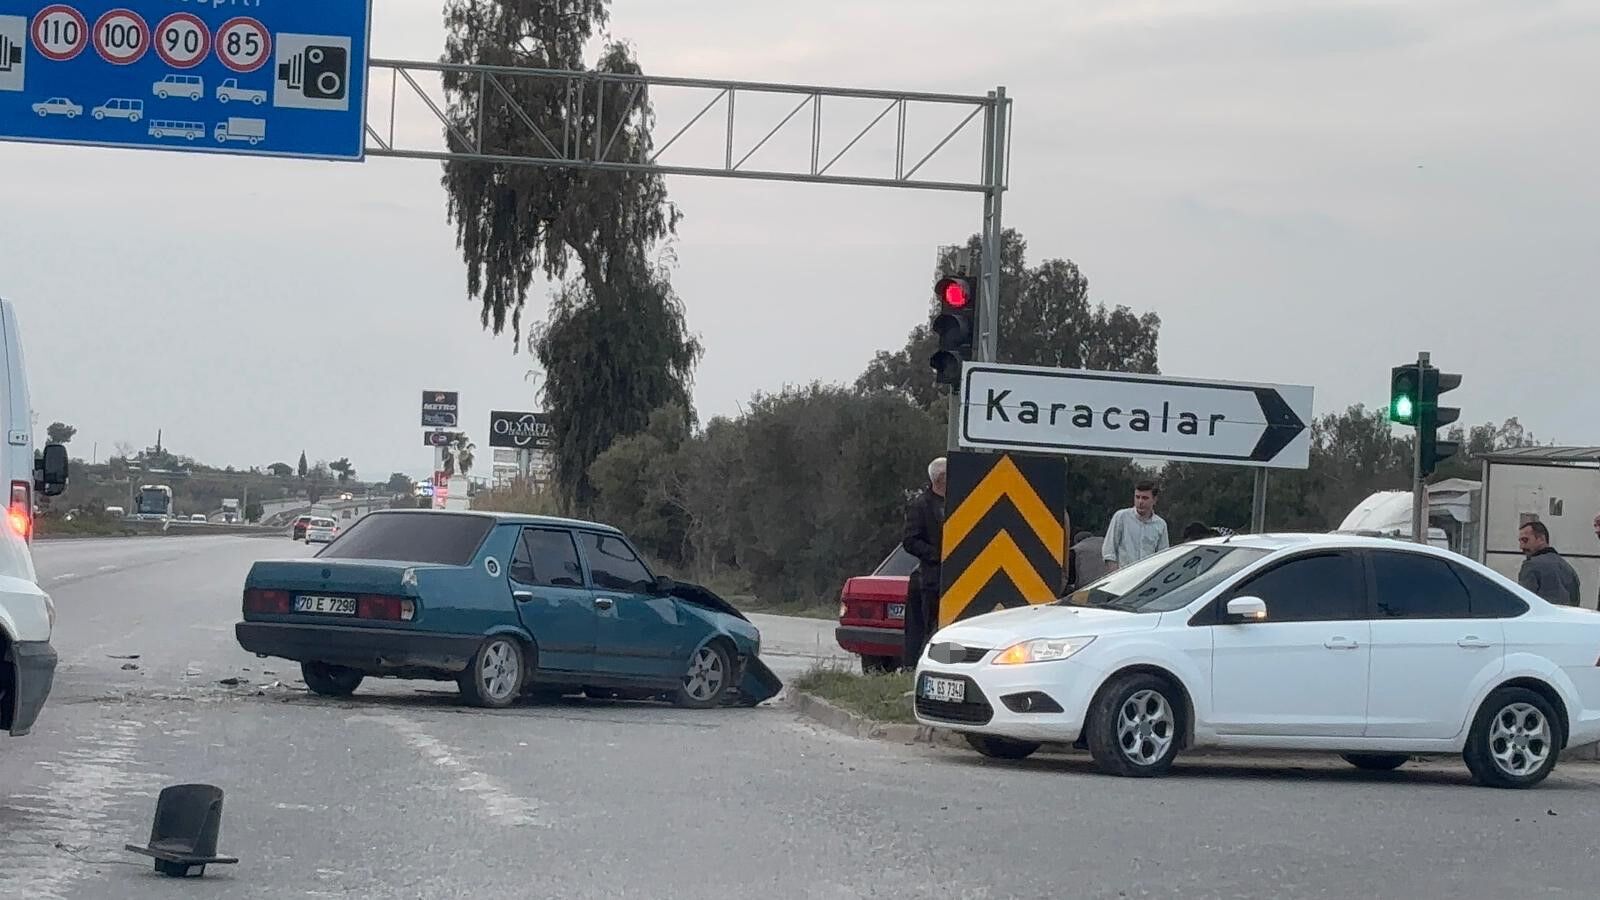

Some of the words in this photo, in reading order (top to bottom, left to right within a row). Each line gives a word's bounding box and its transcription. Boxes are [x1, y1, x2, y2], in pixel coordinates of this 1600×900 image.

[43, 19, 78, 45] 110
[104, 23, 140, 48] 100
[165, 28, 199, 53] 90
[227, 32, 260, 57] 85
[423, 403, 456, 411] METRO
[986, 388, 1226, 436] Karacalar
[300, 597, 313, 610] 70
[316, 598, 325, 611] E
